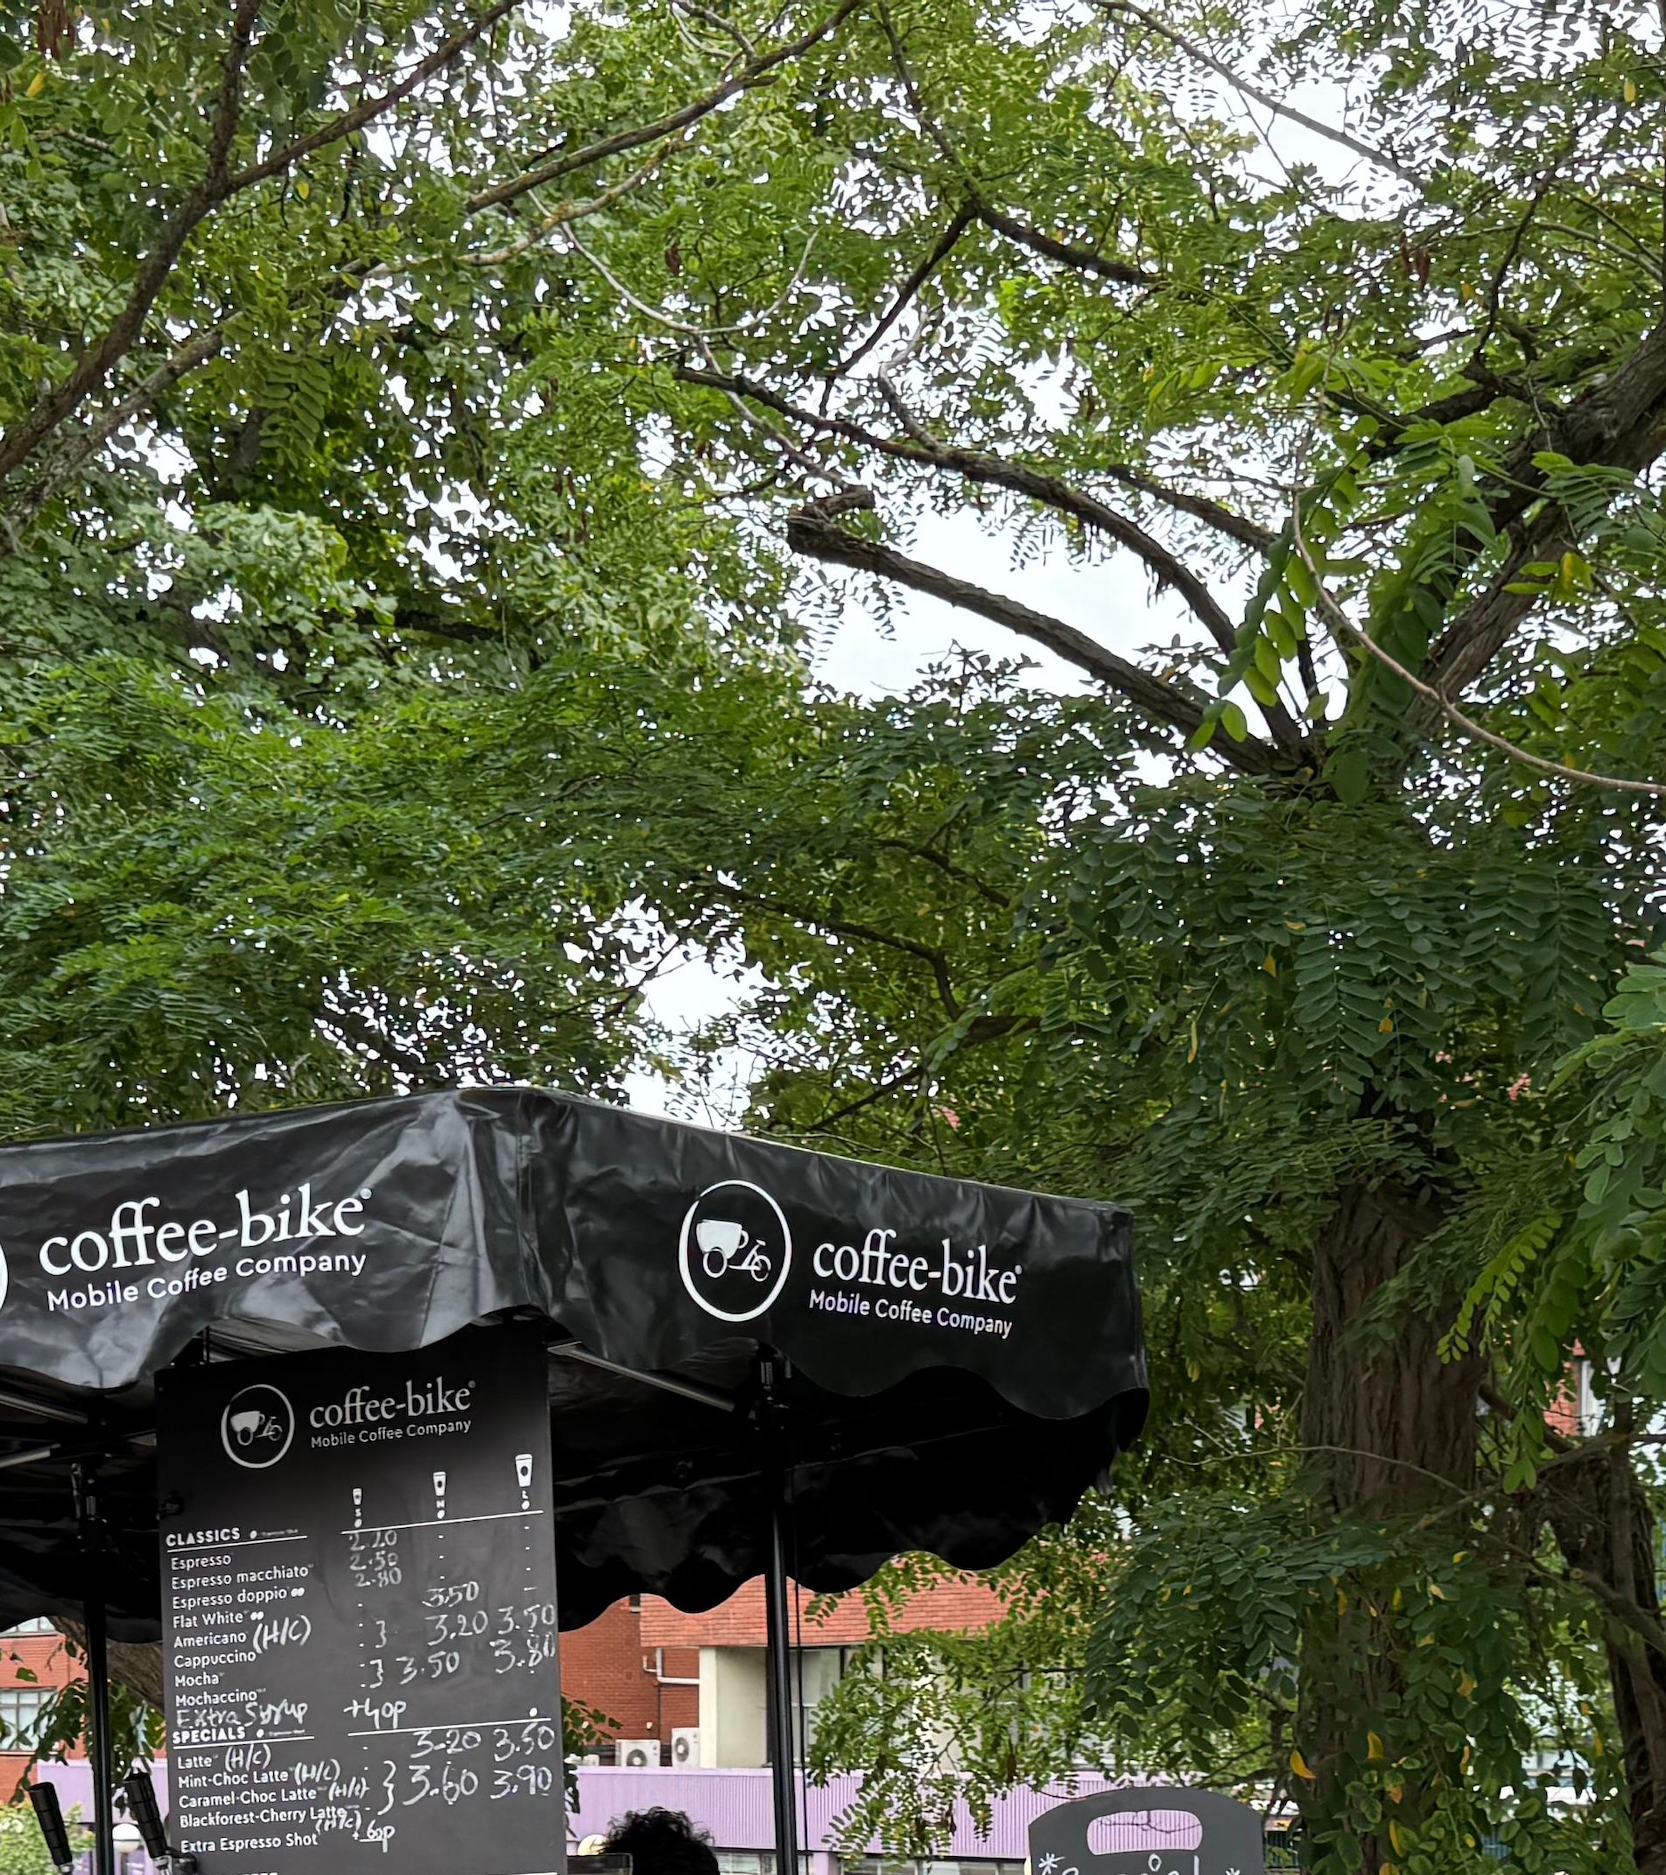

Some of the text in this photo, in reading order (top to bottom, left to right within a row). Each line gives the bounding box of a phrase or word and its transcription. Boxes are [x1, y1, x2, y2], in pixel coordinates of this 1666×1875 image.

[39, 1182, 367, 1275] coffee-bike
[813, 1228, 1019, 1305] coffee-bike
[47, 1250, 367, 1312] Mobile Coffee Company
[809, 1289, 1013, 1340] Mobile Coffee Company
[309, 1376, 472, 1430] coffee-bike
[310, 1418, 472, 1449] Mobile Coffee Company
[165, 1527, 241, 1547] CLASSICS
[171, 1554, 232, 1571] Espresso
[171, 1573, 232, 1592] Espresso
[236, 1565, 309, 1584] macchiato
[172, 1593, 233, 1610] Espresso
[237, 1586, 287, 1604] doppio
[172, 1615, 198, 1629] Flat
[202, 1610, 244, 1626] White
[174, 1632, 247, 1648] Americano
[174, 1649, 256, 1669] Cappuccino
[174, 1672, 220, 1688] Mocha
[175, 1689, 258, 1707] Mochaccino
[172, 1727, 246, 1744] SPECIALS
[177, 1755, 213, 1770] Latte
[178, 1773, 249, 1789] Mint-Choc
[253, 1768, 289, 1783] Latte
[179, 1791, 277, 1809] Caramel-Choc
[282, 1787, 317, 1802] Latte
[180, 1809, 306, 1828] Blackforest-Cherry
[180, 1839, 217, 1854] Extra
[220, 1835, 282, 1852] Espresso
[285, 1833, 318, 1847] Shot
